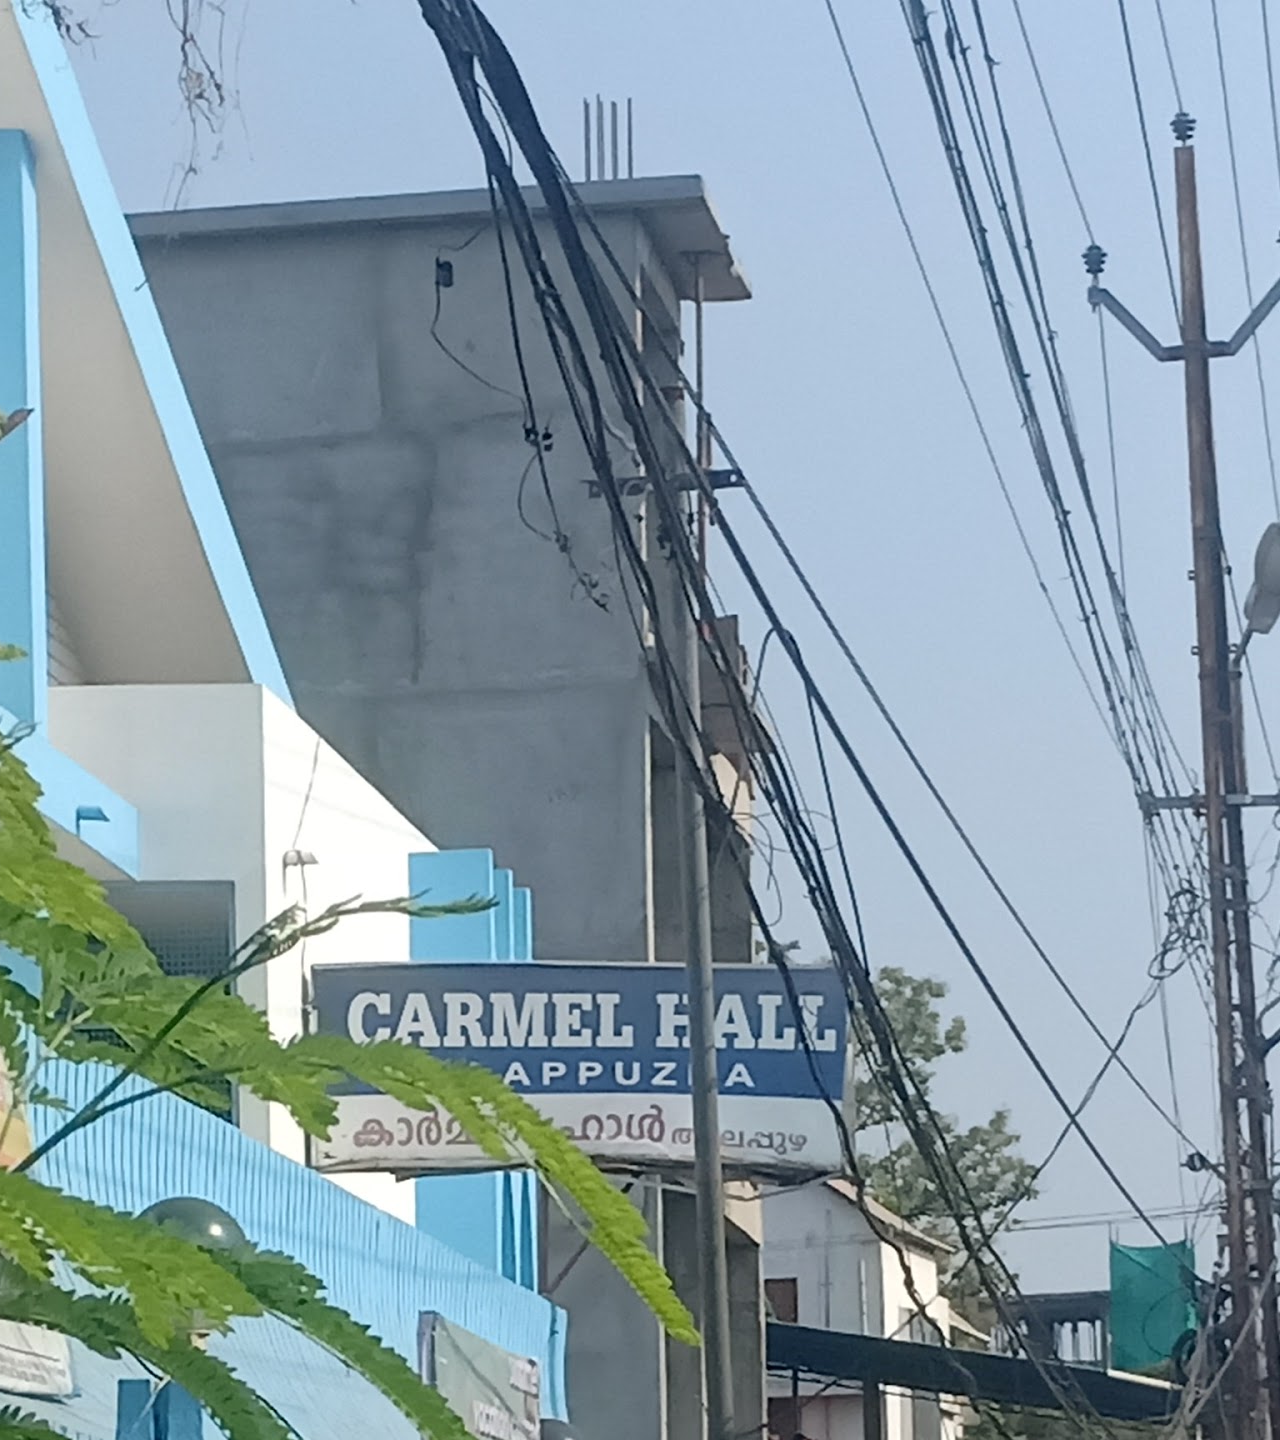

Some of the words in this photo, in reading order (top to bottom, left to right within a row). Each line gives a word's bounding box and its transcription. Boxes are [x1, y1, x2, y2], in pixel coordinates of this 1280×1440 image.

[347, 991, 634, 1048] CARMEL
[655, 992, 837, 1052] HALL
[502, 1061, 756, 1087] APPUZA
